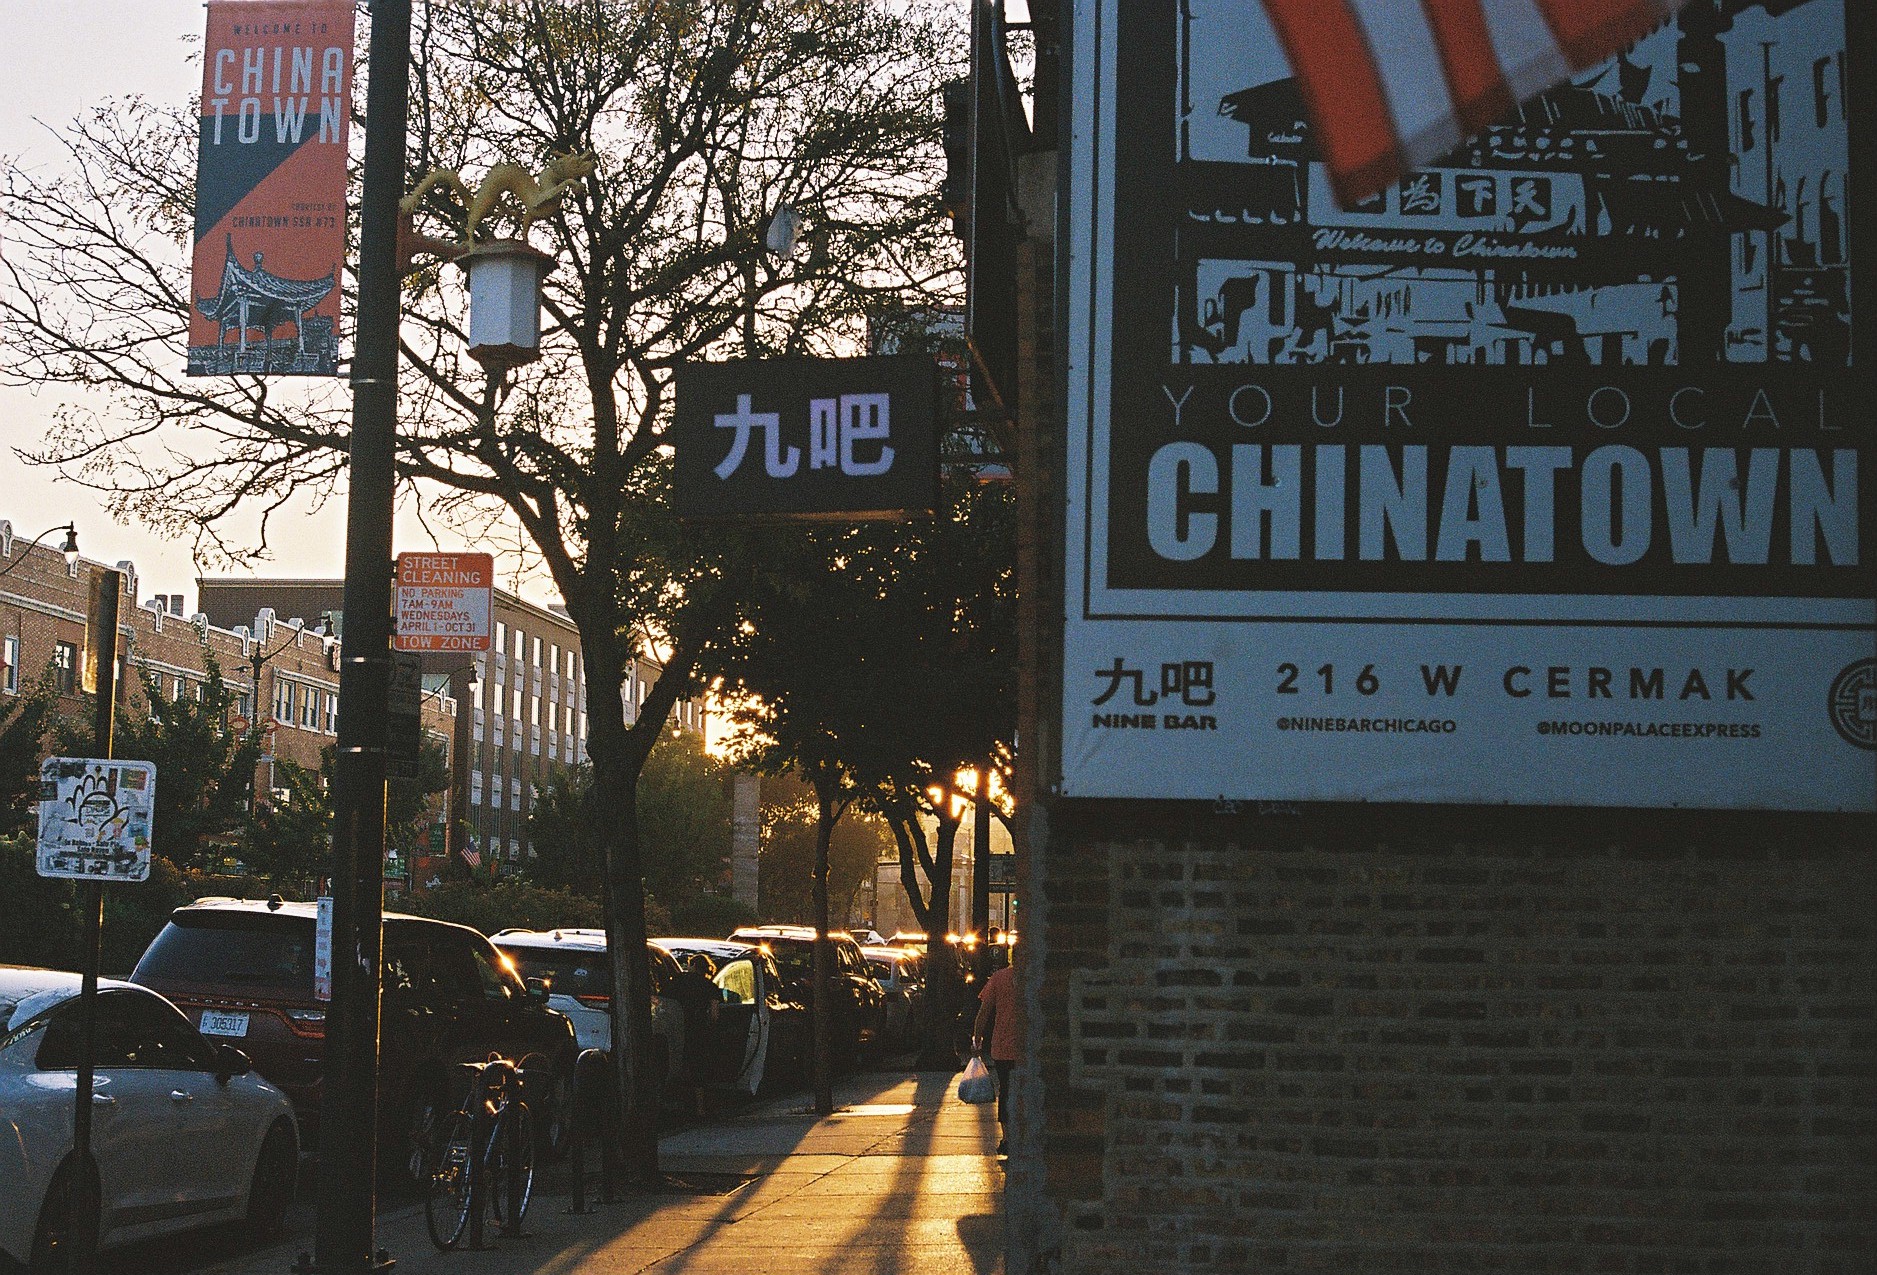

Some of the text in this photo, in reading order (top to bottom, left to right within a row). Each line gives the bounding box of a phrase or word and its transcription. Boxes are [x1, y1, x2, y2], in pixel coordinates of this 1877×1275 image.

[233, 23, 328, 36] WELCOME TO
[214, 46, 344, 95] CHINA
[211, 96, 342, 145] TOWN
[232, 216, 289, 228] CHINATOWN
[292, 217, 312, 228] SSA
[1311, 228, 1579, 259] Welcome to Chinatown
[1162, 384, 1843, 430] YOUR LOCAL
[713, 393, 895, 481] 九吧
[1146, 440, 1859, 566] CHINATOWN
[404, 556, 458, 570] STREET
[403, 570, 481, 584] CLEANING
[401, 588, 464, 599] NO PARKING
[402, 599, 453, 610] 7AM-9AM
[401, 611, 470, 621] WEDNESDAYS
[400, 621, 431, 632] APRIL
[402, 636, 481, 649] TOW ZONE
[1090, 657, 1217, 708] 九吧
[1276, 662, 1756, 701] 216 W CERMAK
[1092, 714, 1218, 731] NINE BAR
[1276, 716, 1457, 734] @NINEBARCHICAGO
[1536, 720, 1762, 739] @MOONPALACEEXPRESS
[211, 1016, 244, 1031] 305317
